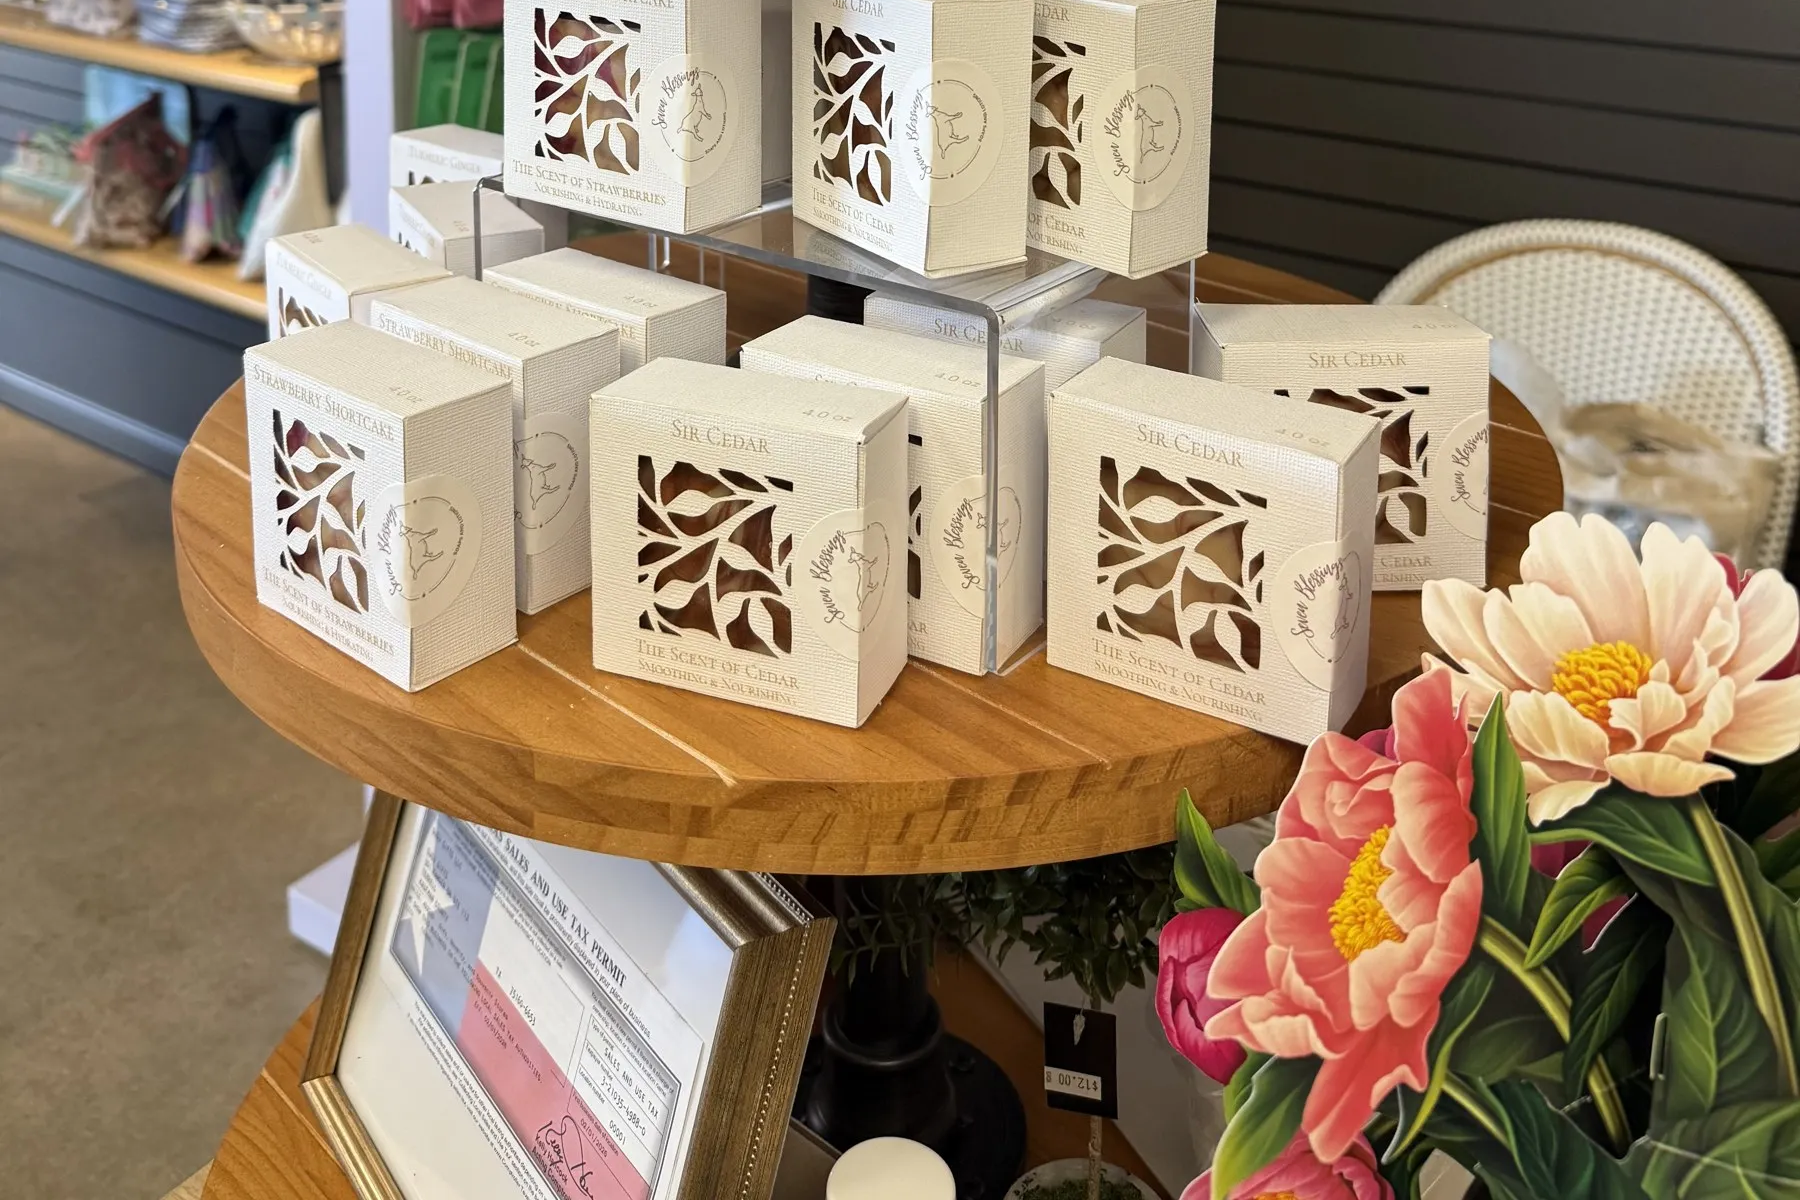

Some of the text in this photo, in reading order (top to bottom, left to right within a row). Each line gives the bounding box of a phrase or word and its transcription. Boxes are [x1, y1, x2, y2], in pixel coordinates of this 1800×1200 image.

[1034, 4, 1069, 23] EDAR
[652, 66, 701, 129] Seven Blessings
[906, 89, 933, 181] Seven Blessings
[1104, 89, 1136, 177] Seven Blessings
[513, 159, 666, 206] THE SCENT OF STRAWBERRIES
[535, 182, 642, 216] NOURISHING & HYDRATING
[811, 186, 895, 237] THE SCENT OF CEDAR
[1028, 214, 1085, 239] OF CEDAR
[379, 314, 513, 379] STRAWBERRY SHORTCAKE
[934, 318, 959, 336] SIR
[1309, 351, 1406, 369] SIR CEDAR
[254, 365, 395, 440] STRAWBERRY SHORTCAKE
[803, 408, 829, 419] 4.0
[672, 419, 769, 454] SIR CEDAR
[1137, 423, 1244, 468] SIR CEDAR
[1450, 425, 1489, 504] Seven Blessings
[378, 504, 402, 596] Seven Blessings
[943, 498, 979, 589] Seven Blessings
[1381, 554, 1431, 568] CEDAR
[809, 529, 846, 625] Seven Blessings
[1291, 557, 1343, 639] Seven Blessings
[263, 567, 395, 655] THE SCENT OF STRAWBERRIES
[636, 638, 799, 690] THE SCENT OF CEDAR
[638, 659, 797, 707] SMOOTHING & NOURISHING
[1092, 638, 1265, 705] THE SCENT OF CEDAR
[1094, 659, 1262, 722] SMOOTHING & NOURISHING
[505, 838, 627, 988] SALES AND USE TAX PERMIT
[574, 942, 596, 971] displayed
[599, 972, 611, 989] your
[610, 986, 623, 1005] place
[623, 1001, 629, 1012] of
[604, 1047, 659, 1120] SALES AND USE TAX
[1058, 1073, 1098, 1091] $12.00
[609, 1119, 626, 1145] 00001
